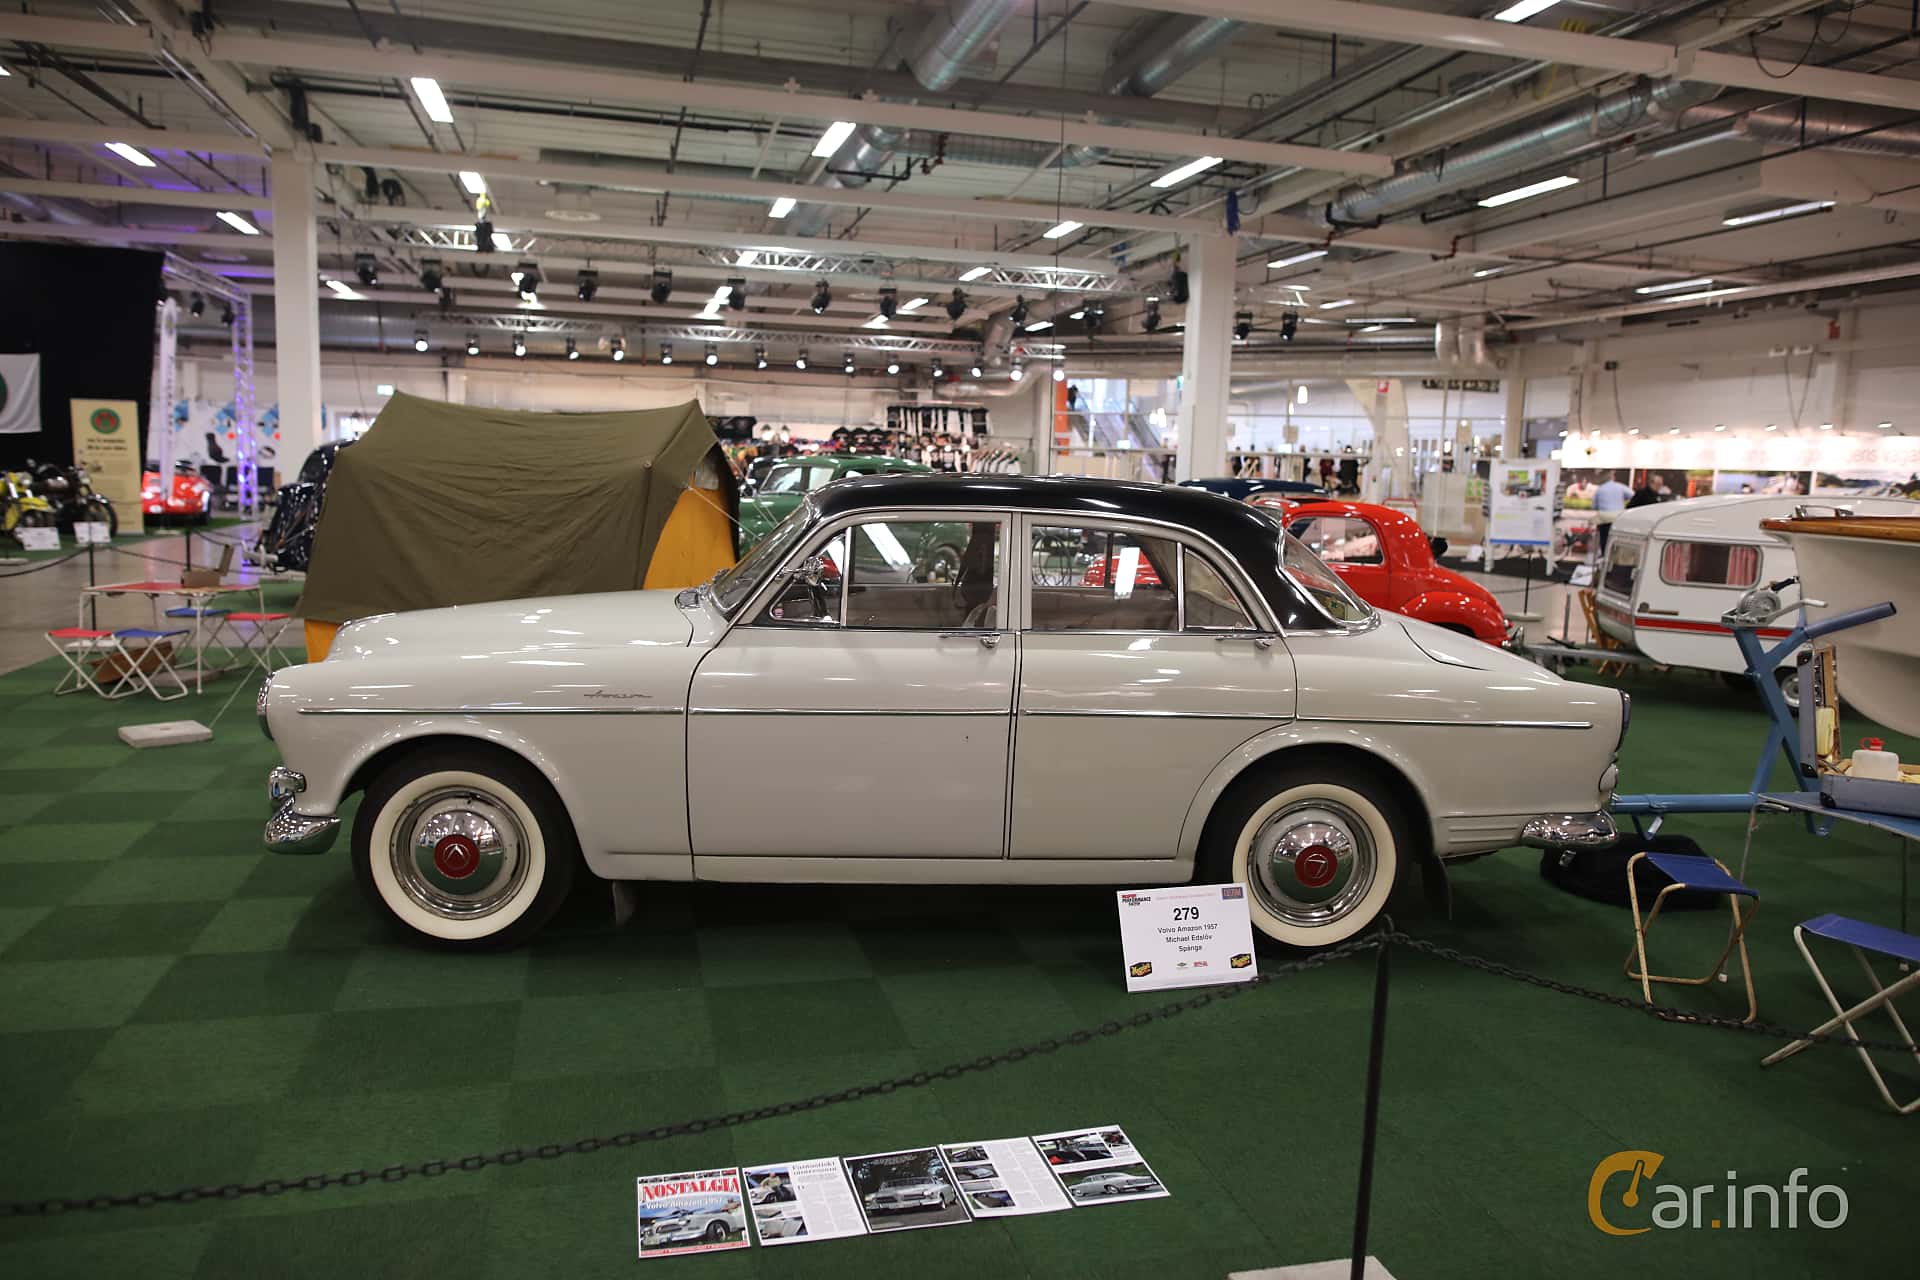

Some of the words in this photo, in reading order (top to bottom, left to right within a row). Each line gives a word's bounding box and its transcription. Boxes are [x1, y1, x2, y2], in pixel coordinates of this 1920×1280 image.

[1173, 906, 1200, 921] 279
[1157, 926, 1176, 934] Volvo
[1177, 924, 1202, 933] Amazon
[1203, 923, 1218, 931] 1957
[1165, 935, 1190, 943] Michael
[642, 1177, 740, 1202] NOSTALGIA
